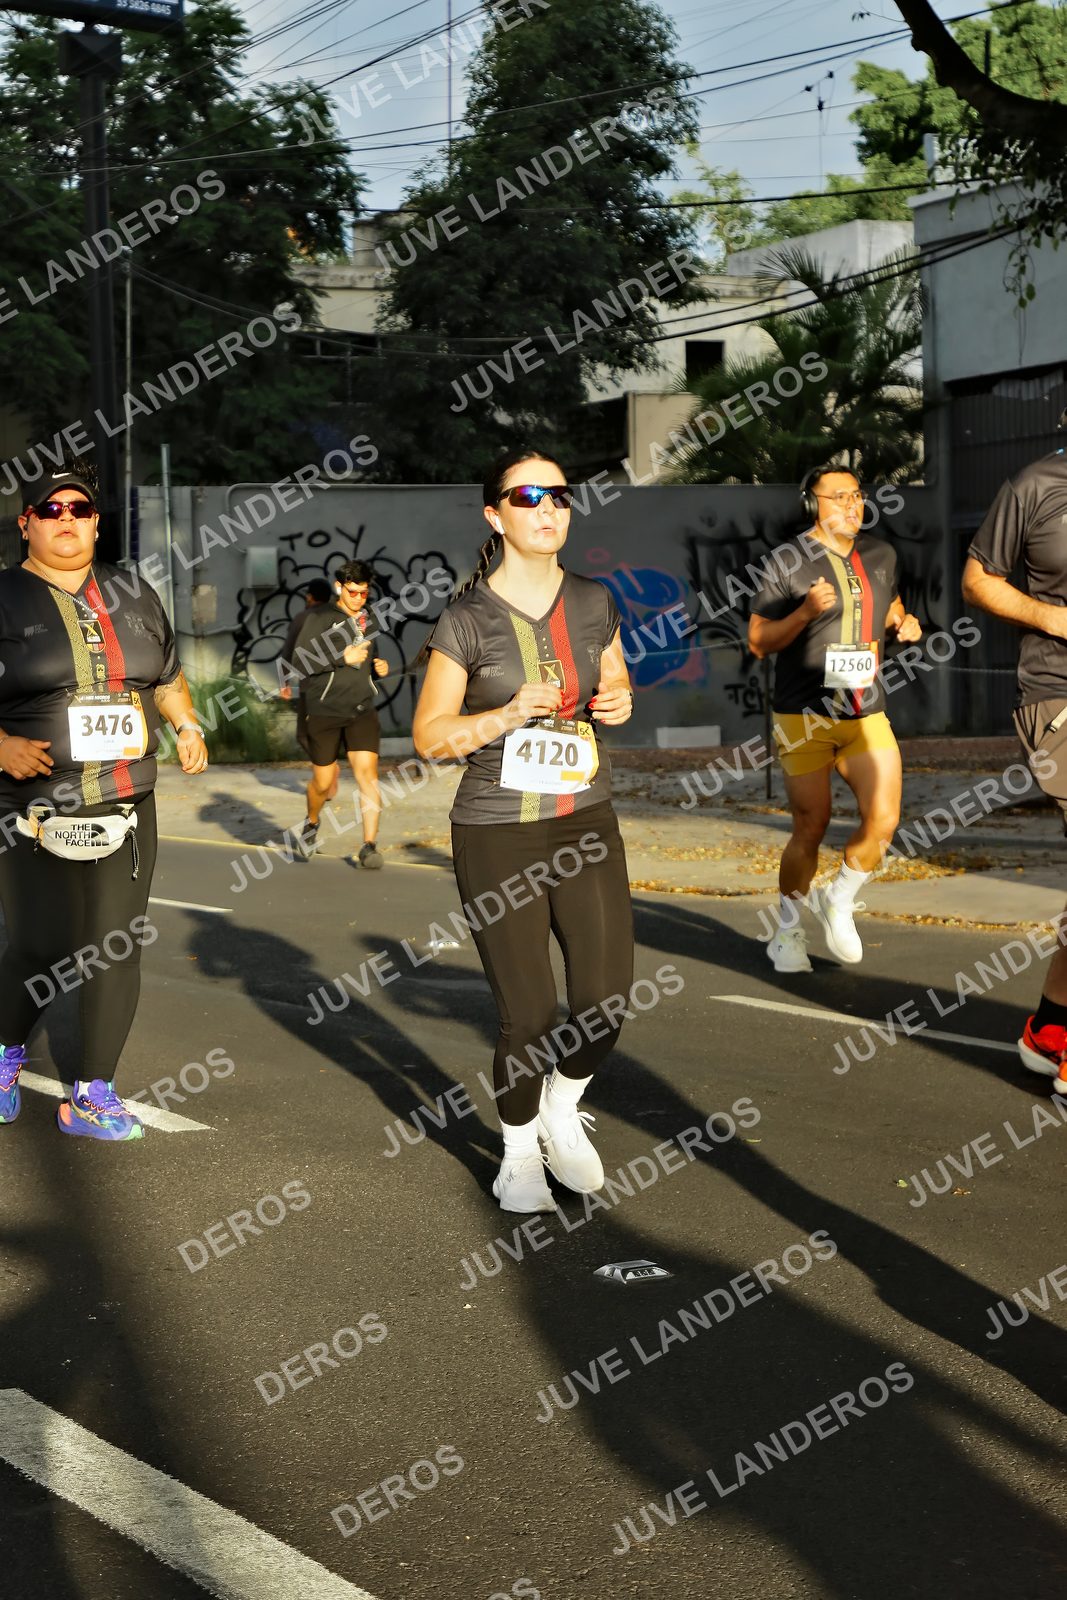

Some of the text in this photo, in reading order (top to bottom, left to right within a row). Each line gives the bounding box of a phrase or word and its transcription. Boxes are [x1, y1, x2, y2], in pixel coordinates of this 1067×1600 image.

[279, 524, 365, 558] TOY
[831, 657, 872, 673] 12560
[81, 714, 133, 736] 3476
[516, 739, 579, 767] 4120
[55, 831, 91, 839] NORTH
